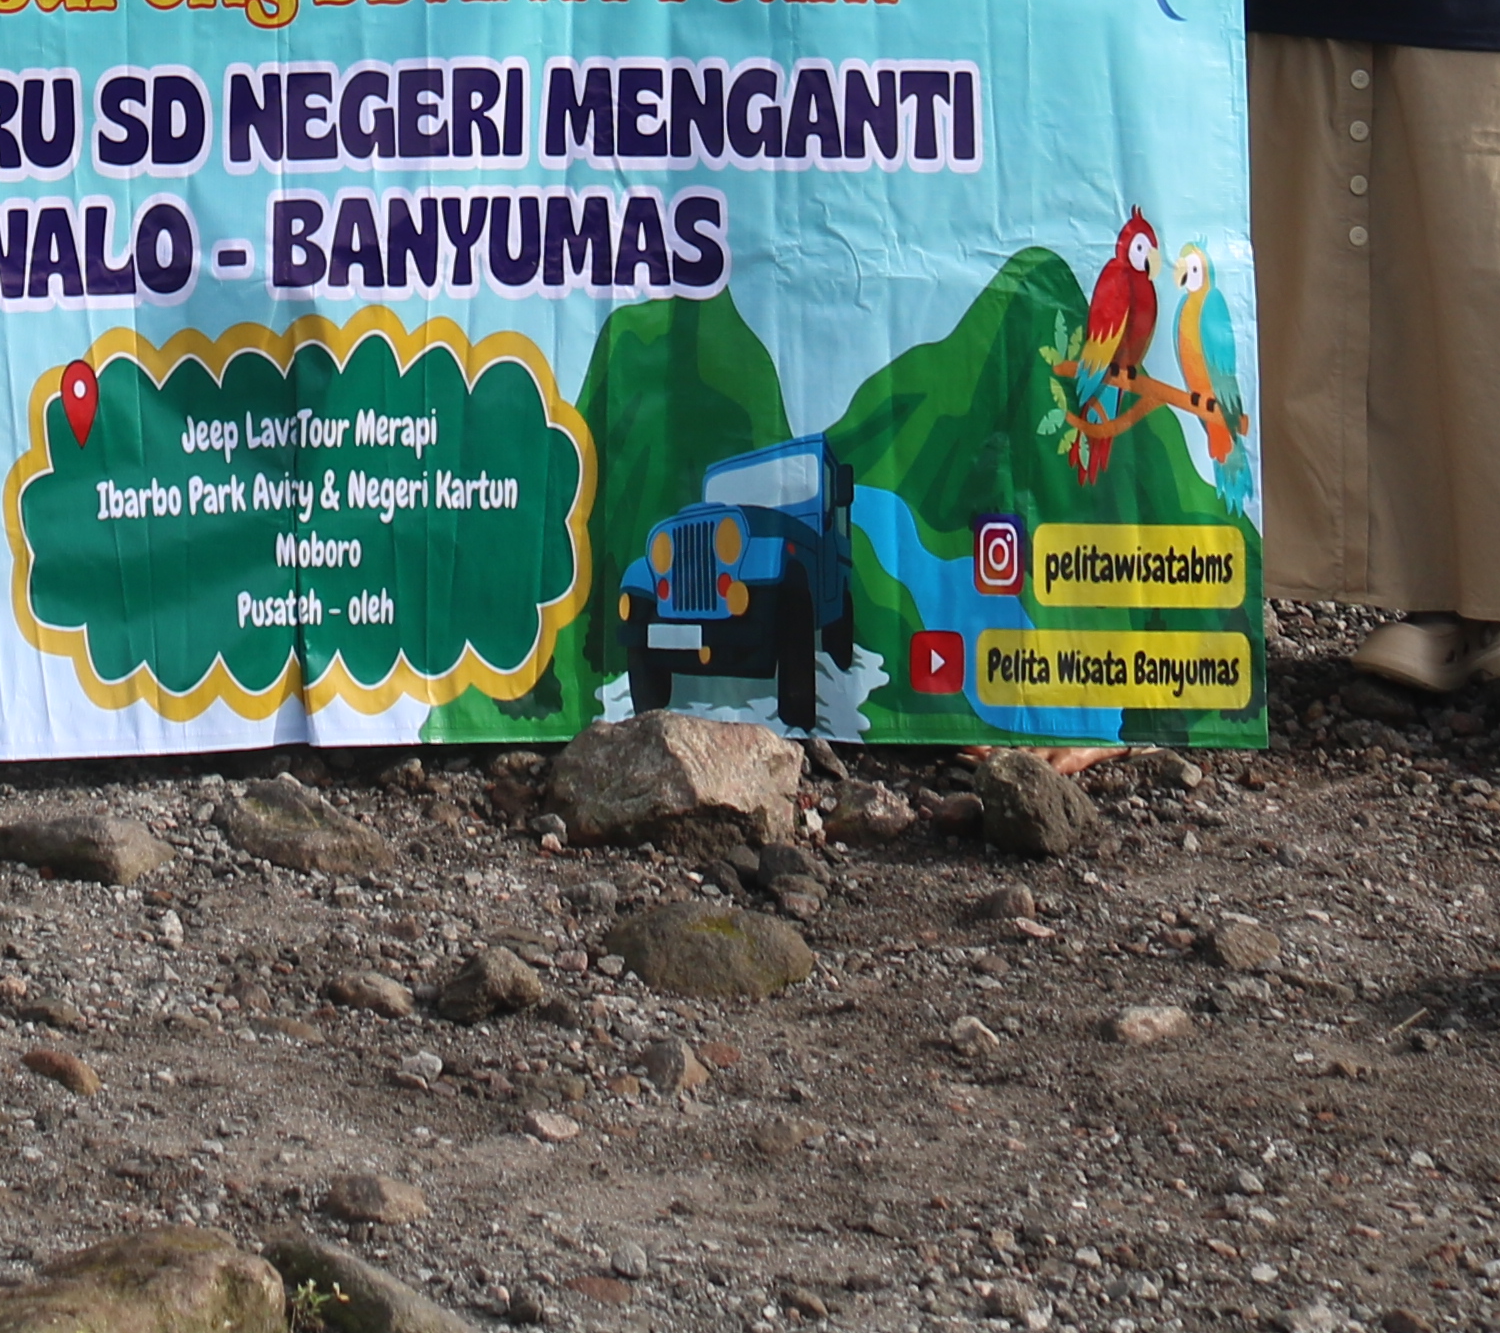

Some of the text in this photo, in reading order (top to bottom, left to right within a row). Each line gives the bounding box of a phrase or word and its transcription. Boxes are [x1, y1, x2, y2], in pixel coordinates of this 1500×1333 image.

[98, 75, 202, 167] SD
[229, 68, 523, 163] NEGERI
[547, 67, 977, 162] MENGANTI
[273, 195, 724, 289] BANYUMAS
[182, 414, 239, 463] Jeep
[297, 408, 350, 449] Tour
[355, 408, 438, 459] Merapi
[96, 478, 182, 520] Ibarbo
[188, 474, 247, 515] Park
[320, 469, 340, 511] &
[348, 470, 429, 524] Negeri
[435, 470, 518, 510] Kartun
[1045, 545, 1233, 594] pelitawisatabms
[348, 587, 394, 625] oleh
[987, 647, 1240, 697] Pelita Wisata Banyumas
